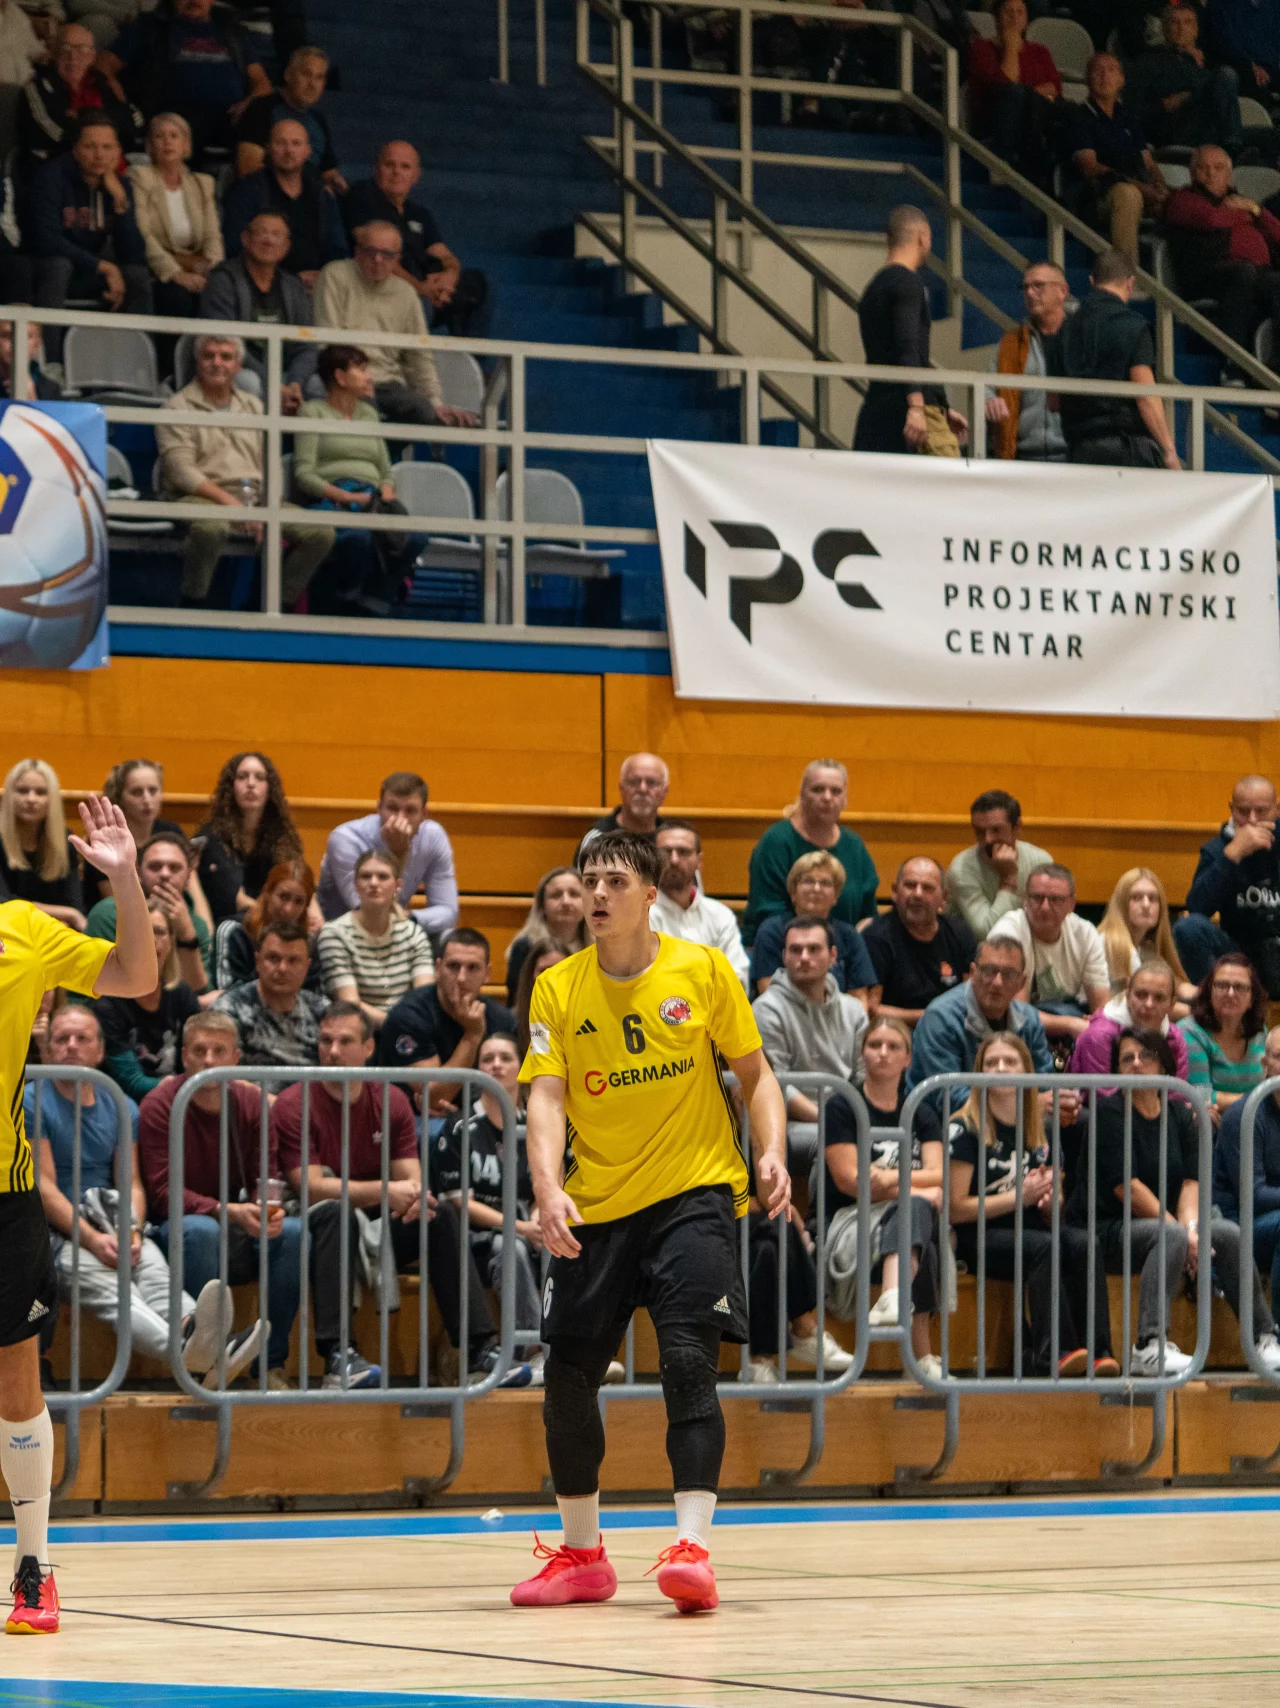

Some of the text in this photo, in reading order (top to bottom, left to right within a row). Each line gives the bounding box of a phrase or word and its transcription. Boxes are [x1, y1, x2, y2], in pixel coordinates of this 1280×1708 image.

[942, 537, 1241, 575] INFORMACIJSKO
[943, 583, 1238, 620] PROJEKTANTSKI
[945, 629, 1084, 660] CENTAR
[622, 1013, 646, 1055] 6
[608, 1055, 695, 1088] GERMANIA
